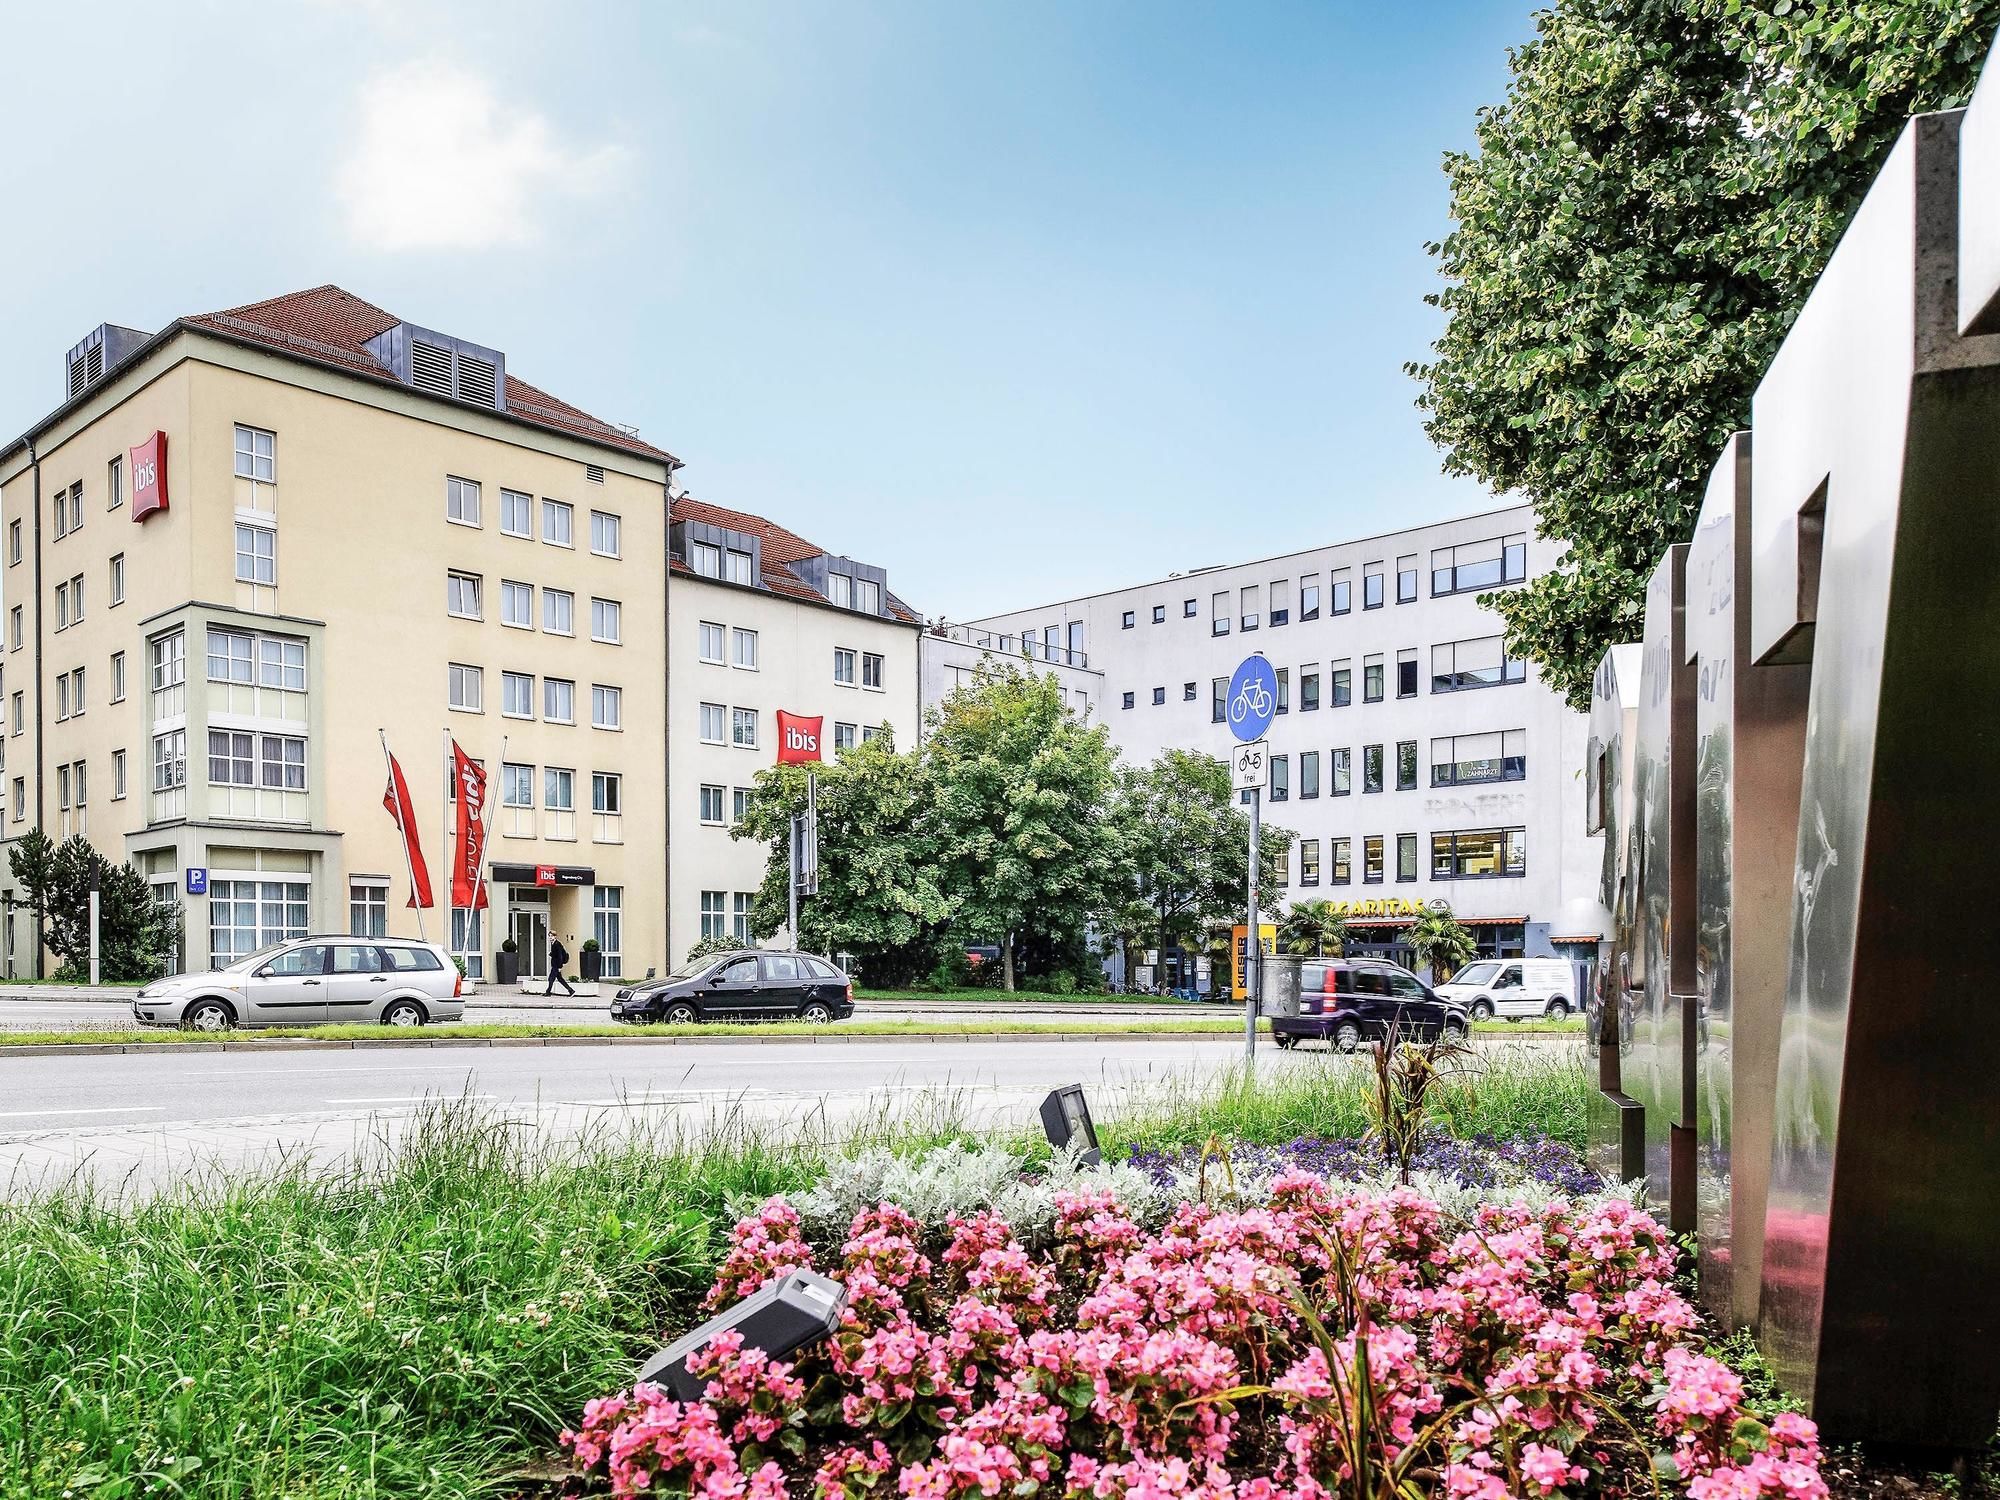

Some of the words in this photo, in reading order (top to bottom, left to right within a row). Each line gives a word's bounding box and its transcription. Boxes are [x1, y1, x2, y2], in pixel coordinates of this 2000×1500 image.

[135, 458, 155, 492] ibis
[786, 727, 817, 752] ibis
[1244, 772, 1255, 783] frei
[191, 870, 202, 885] P
[540, 870, 556, 880] ibis
[1238, 937, 1246, 988] KIESER
